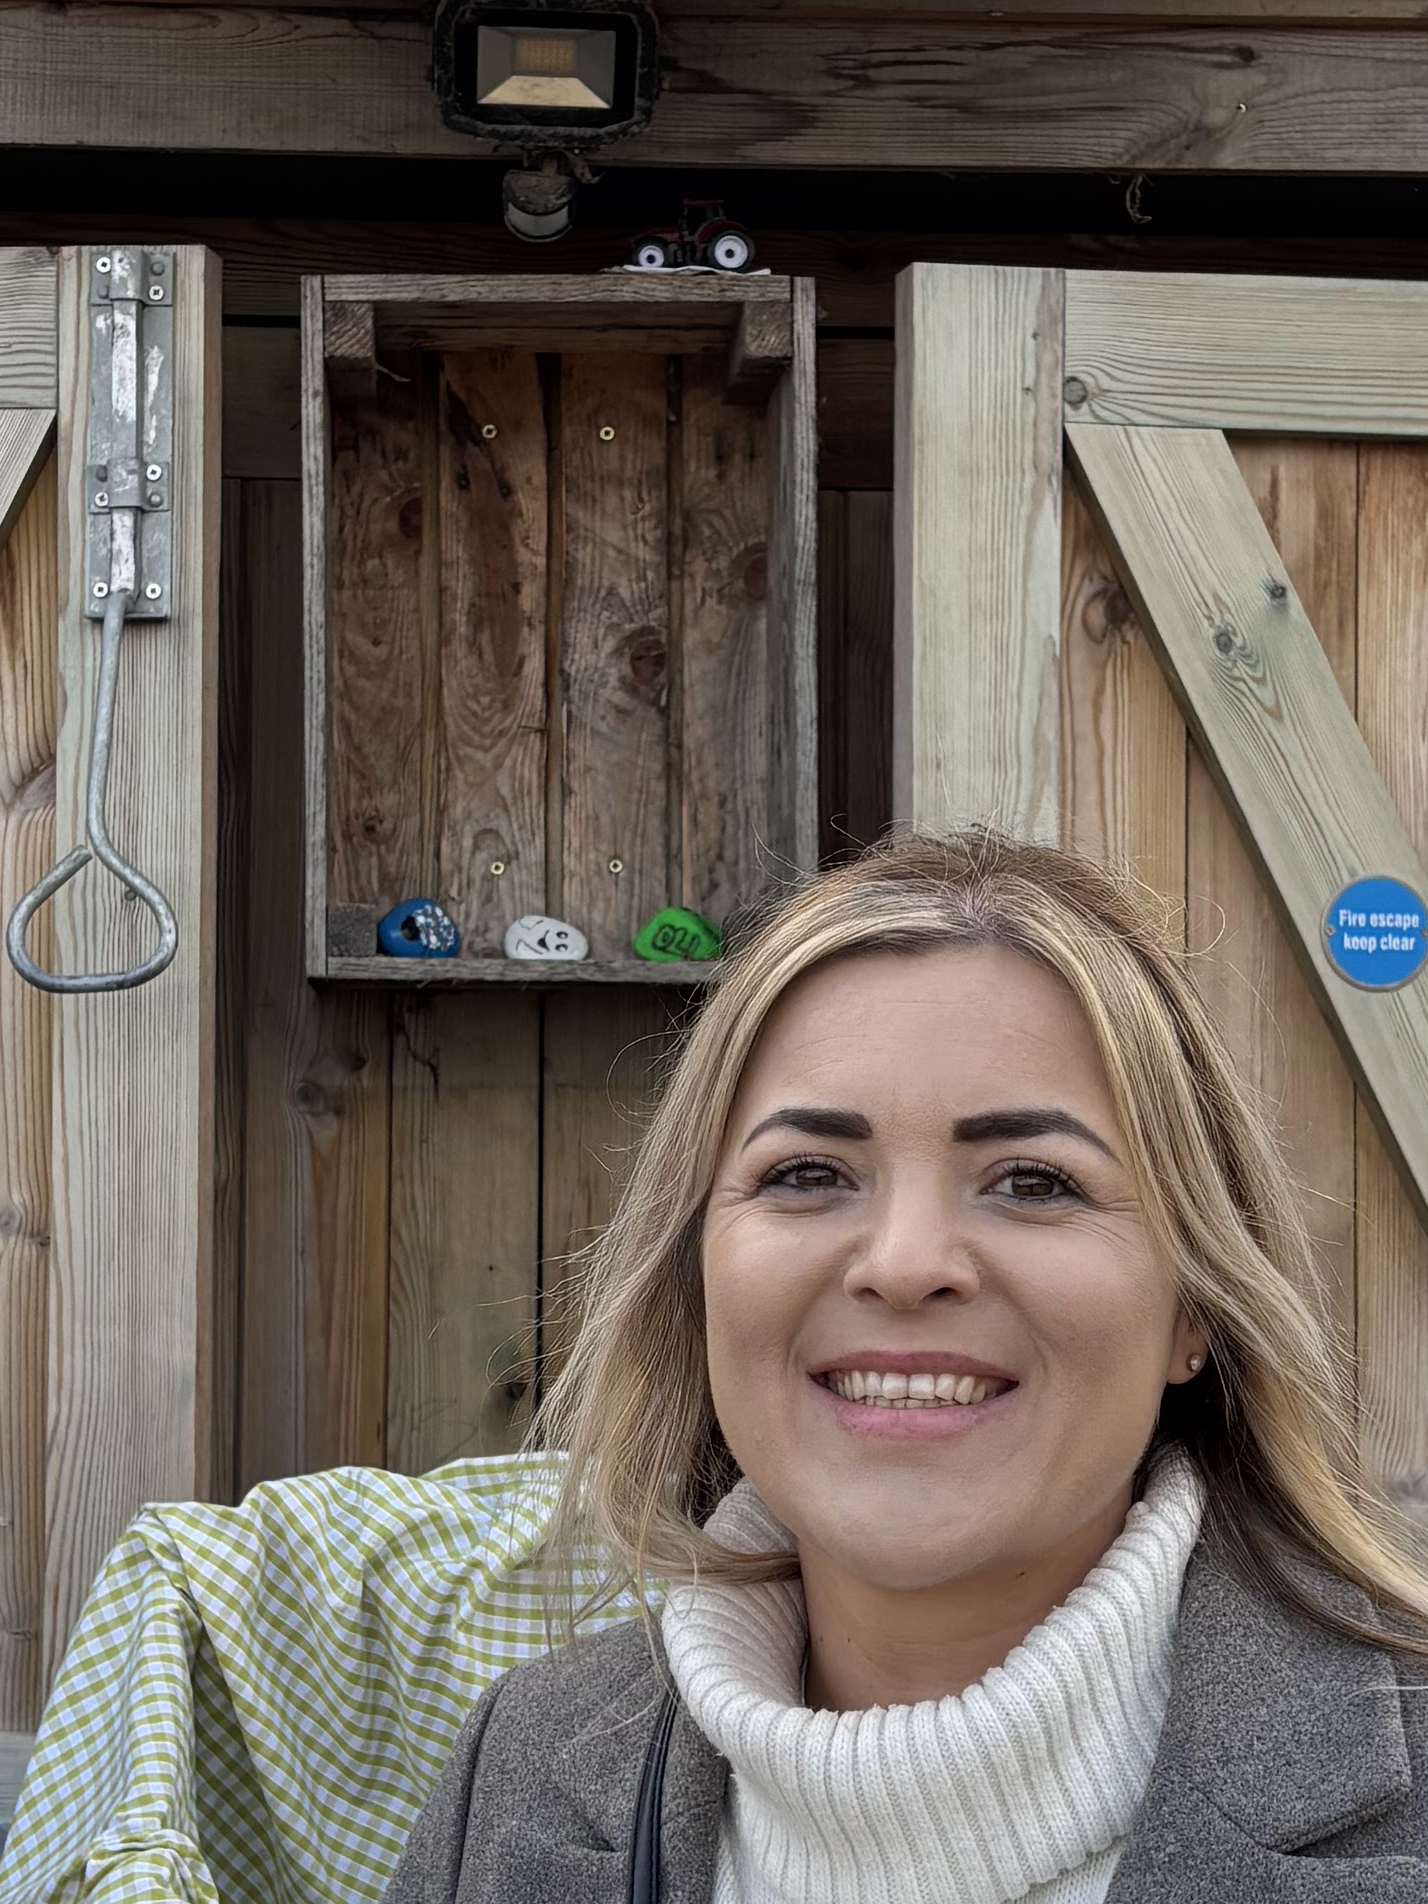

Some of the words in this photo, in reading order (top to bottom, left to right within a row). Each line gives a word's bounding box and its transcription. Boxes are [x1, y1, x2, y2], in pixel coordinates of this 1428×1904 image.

[1338, 909, 1366, 927] Fire
[1370, 912, 1420, 931] escape
[1343, 932, 1377, 954] keep
[1380, 933, 1416, 951] clear
